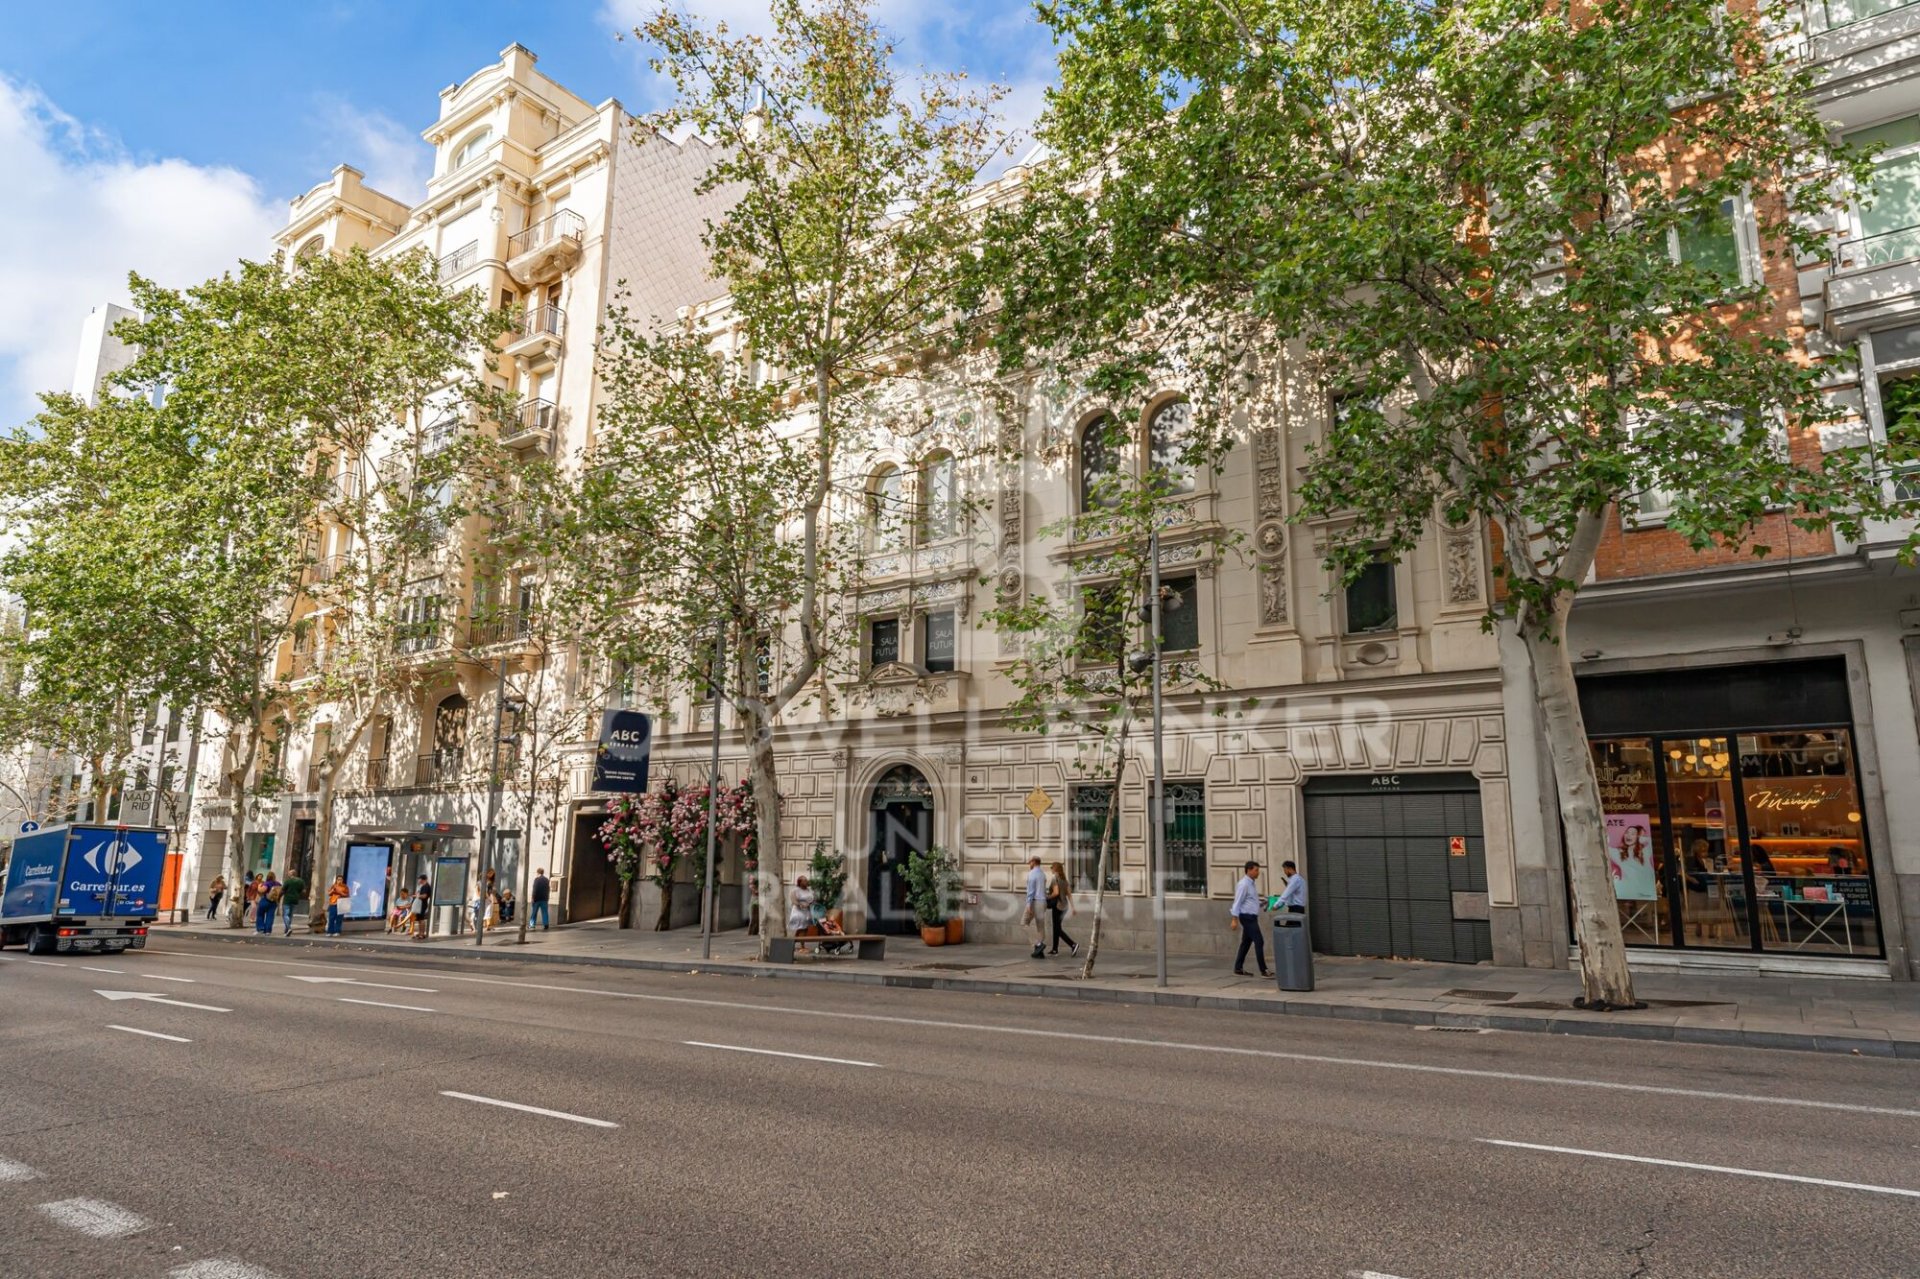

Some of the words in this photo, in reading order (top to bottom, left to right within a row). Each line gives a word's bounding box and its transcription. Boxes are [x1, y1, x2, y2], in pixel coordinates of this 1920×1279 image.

[935, 630, 953, 639] SALA
[610, 729, 640, 742] ABC
[1371, 775, 1400, 785] ABC
[123, 791, 151, 802] MAD
[132, 801, 150, 811] RID
